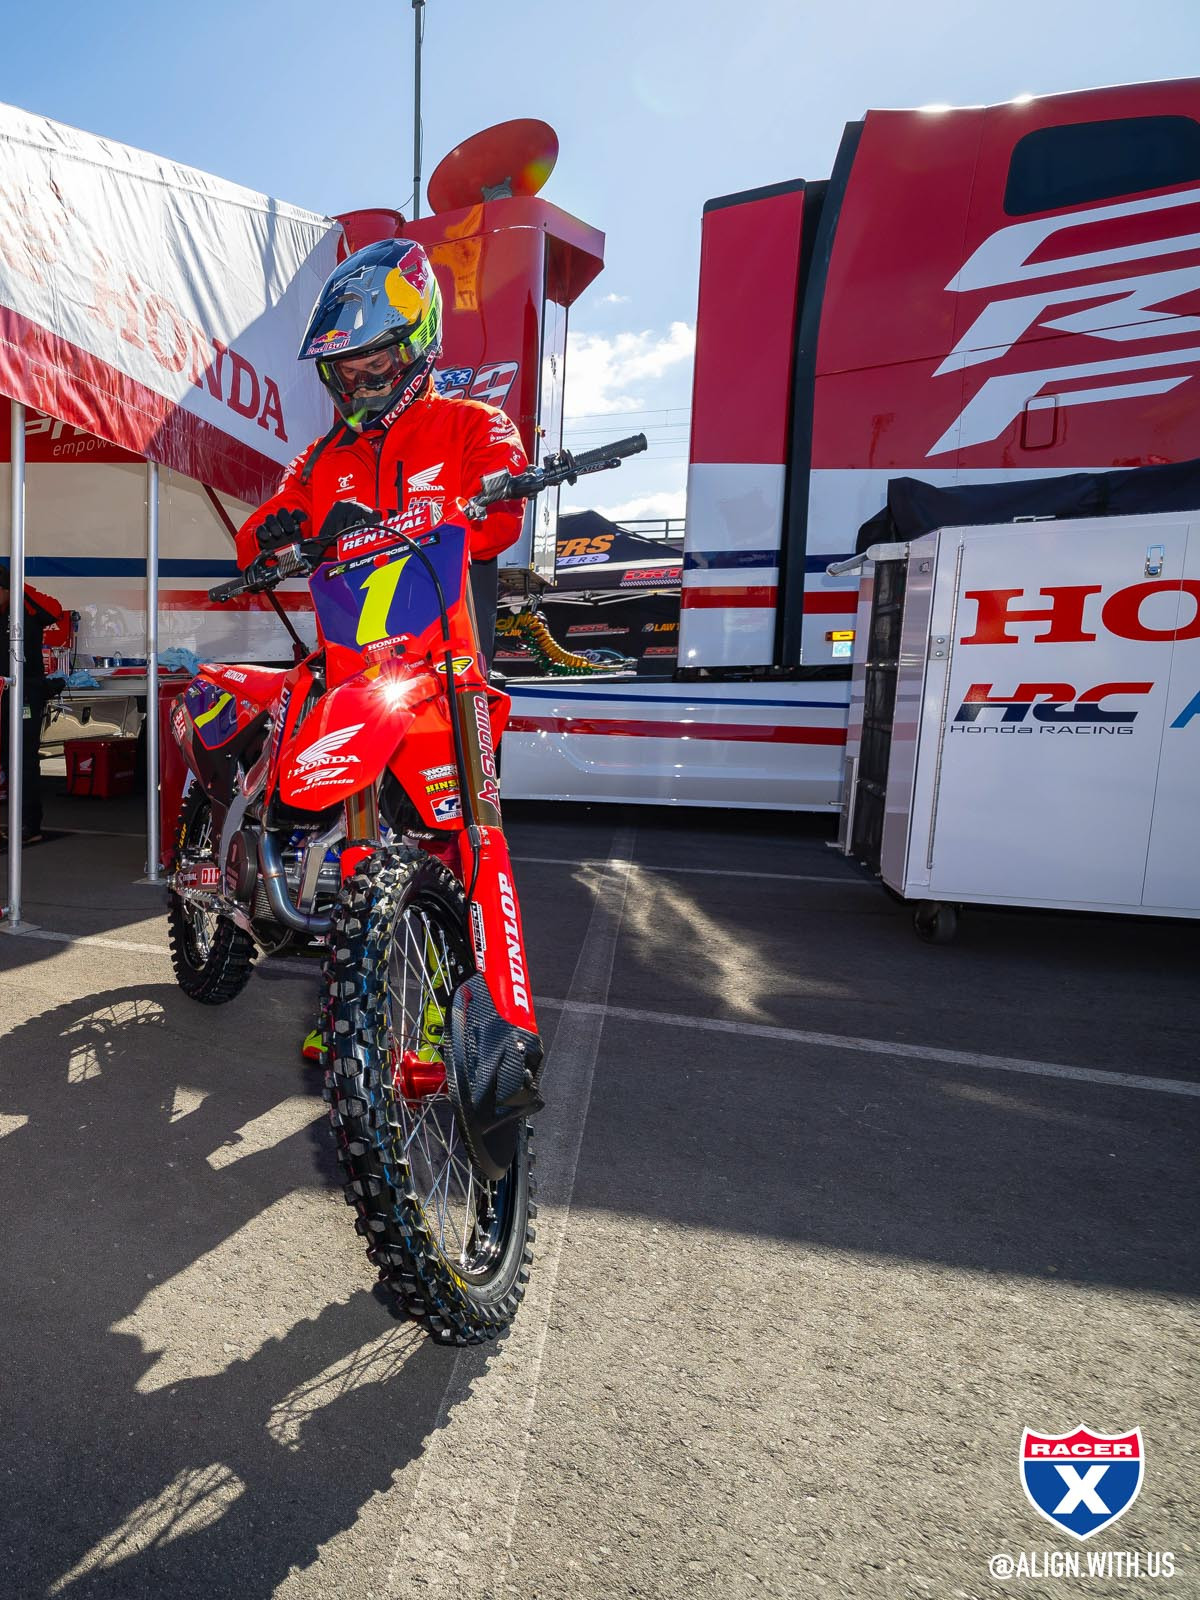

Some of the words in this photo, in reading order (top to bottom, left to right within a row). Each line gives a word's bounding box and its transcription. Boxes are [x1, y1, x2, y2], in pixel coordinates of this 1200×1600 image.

[52, 433, 116, 456] empow
[408, 484, 445, 493] HONDA
[557, 534, 615, 556] ERS
[356, 554, 413, 646] 1
[367, 635, 409, 652] HONDA
[954, 682, 1154, 723] HRC
[474, 696, 497, 778] SHOWA
[950, 725, 1033, 735] Honda
[1040, 725, 1134, 735] RACING
[293, 755, 361, 778] HONDA
[312, 778, 355, 789] Honda
[425, 780, 457, 793] HINS
[498, 872, 530, 1013] DUNLOP
